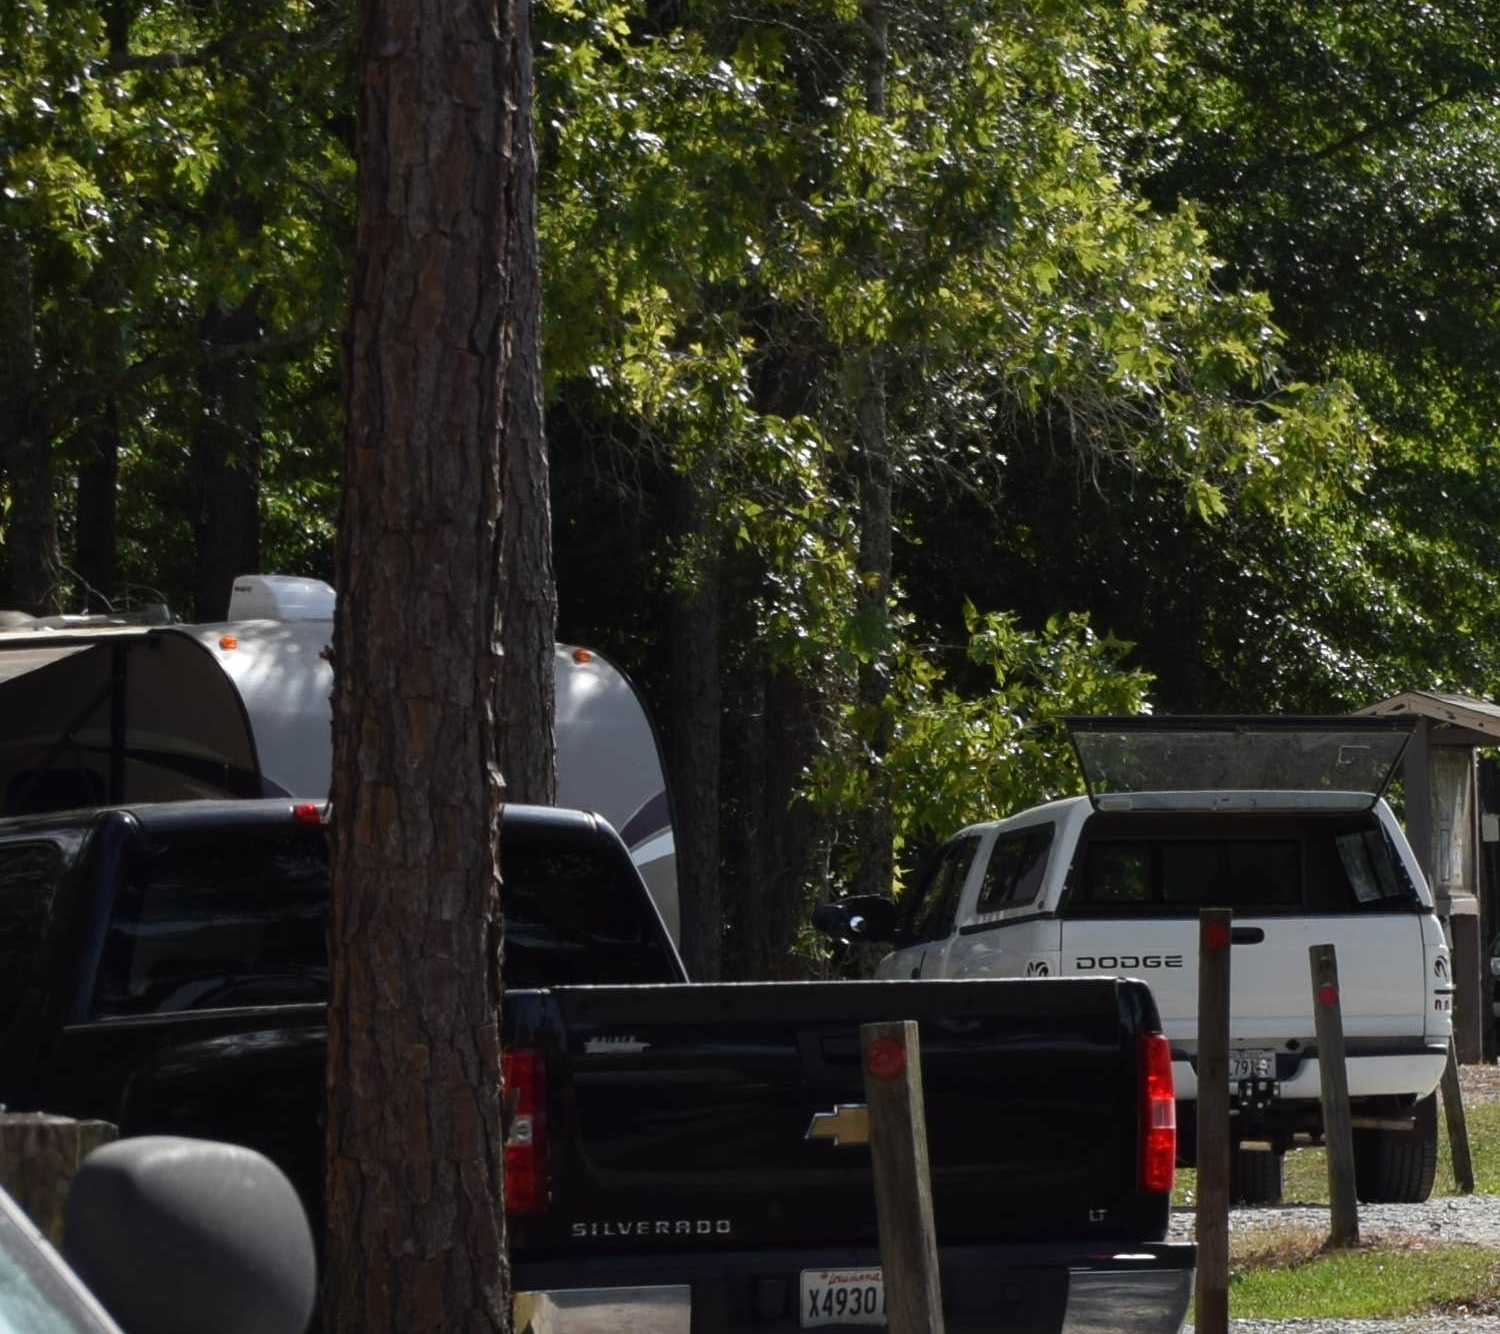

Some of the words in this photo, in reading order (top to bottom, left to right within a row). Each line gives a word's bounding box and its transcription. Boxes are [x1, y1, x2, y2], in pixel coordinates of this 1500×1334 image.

[1076, 955, 1183, 970] DODGE
[1089, 1209, 1108, 1222] LT
[571, 1220, 732, 1238] SILVERADO
[809, 1287, 886, 1318] X4930
